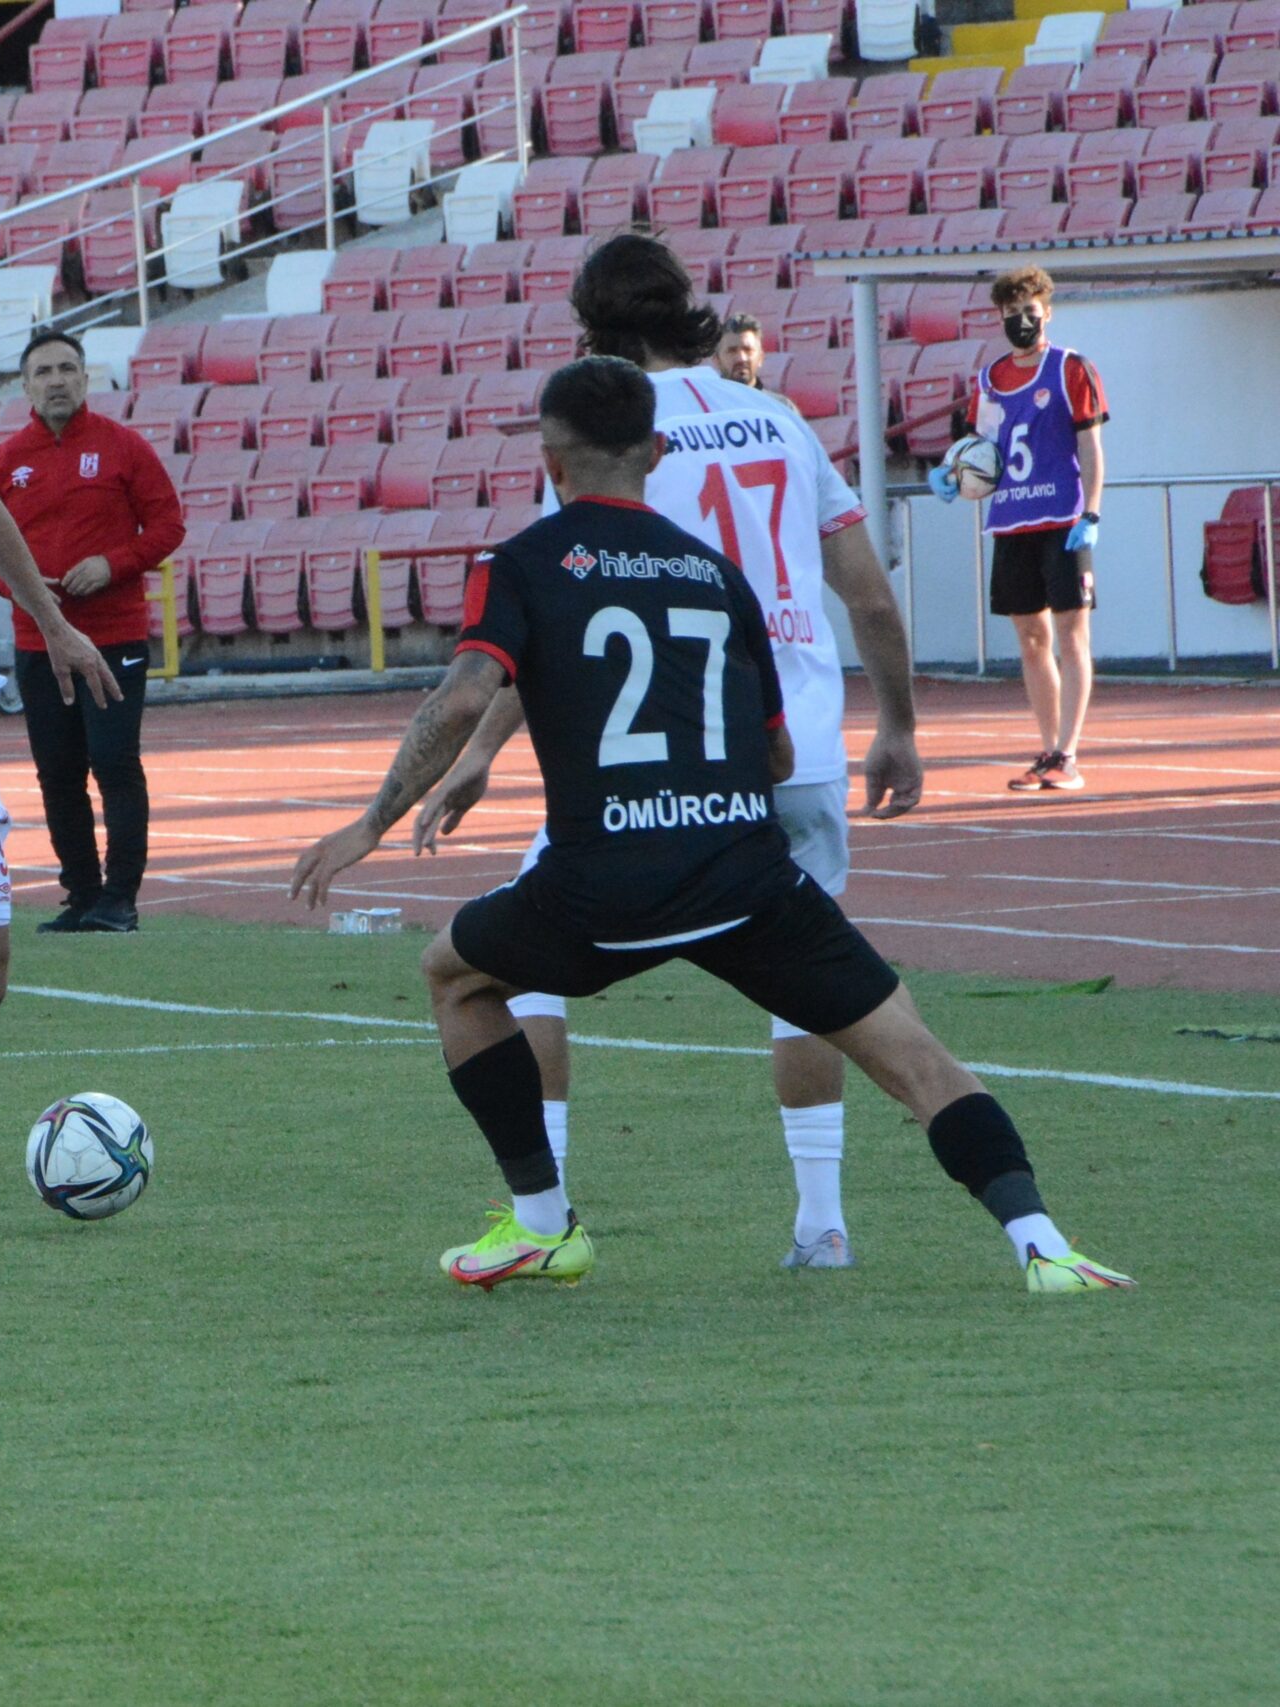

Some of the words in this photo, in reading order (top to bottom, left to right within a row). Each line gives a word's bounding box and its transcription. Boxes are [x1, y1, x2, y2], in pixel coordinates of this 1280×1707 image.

[1007, 423, 1033, 482] 5
[697, 459, 791, 600] 17
[598, 549, 725, 590] hidrolift
[582, 606, 732, 767] 27
[602, 789, 768, 832] ÖMÜRCAN
